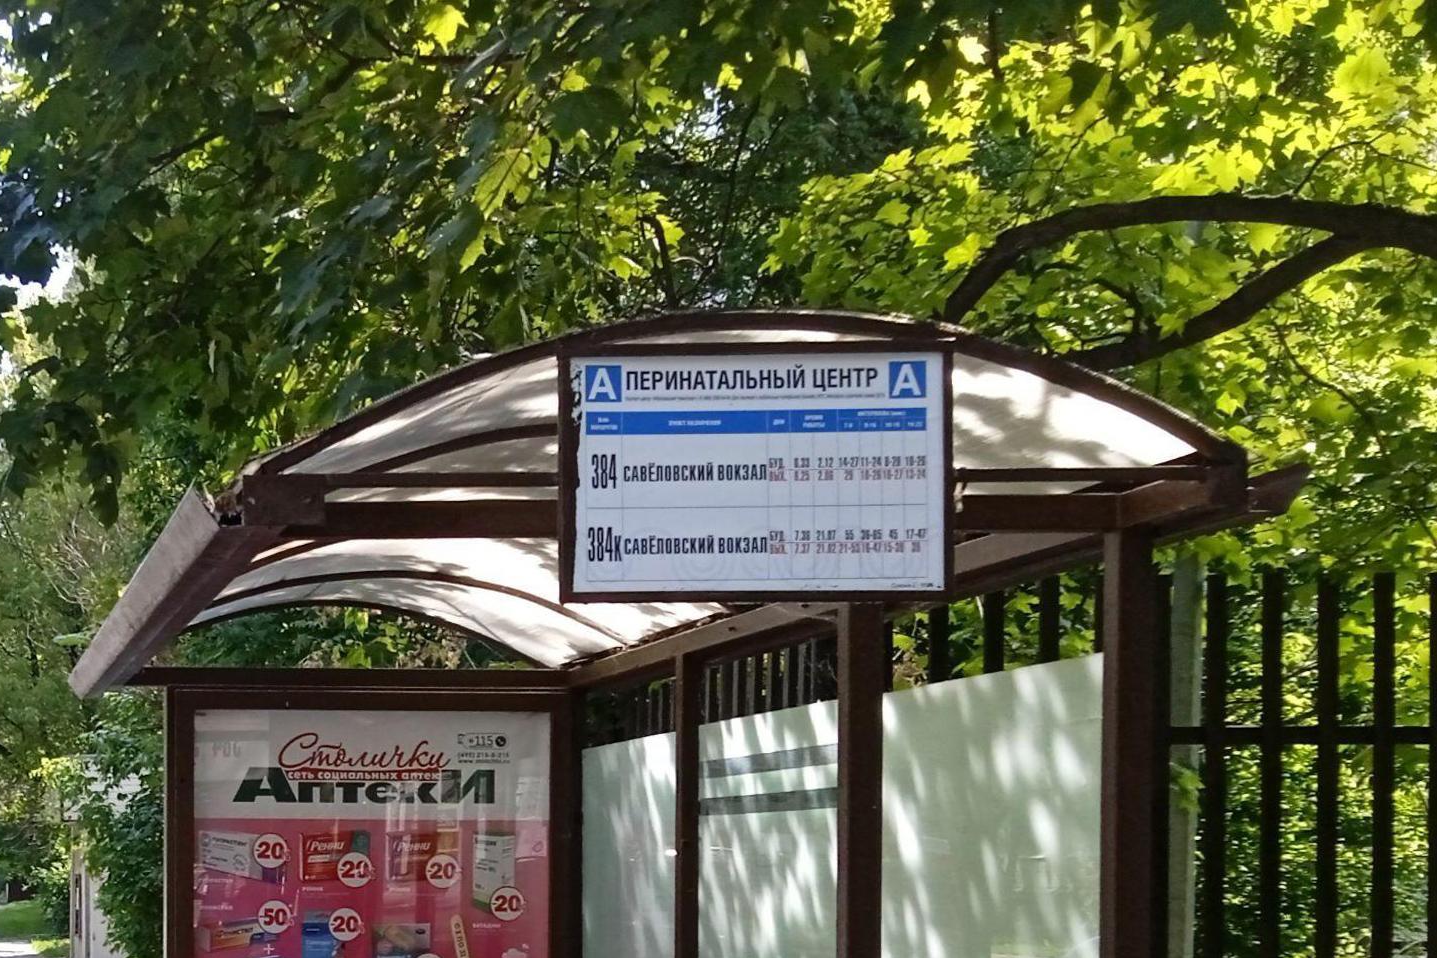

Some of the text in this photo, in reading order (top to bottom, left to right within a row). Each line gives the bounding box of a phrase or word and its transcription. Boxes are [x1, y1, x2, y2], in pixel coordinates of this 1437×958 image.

[626, 365, 805, 391] ПЕРИНАТАЛЬНЫЙ
[813, 367, 879, 392] ЦЕНТР
[591, 454, 617, 489] 384
[624, 462, 767, 483] САВЁЛОВСКИЙ ВОКЗАЛ
[624, 534, 768, 555] САВЁЛОВСКИЙ ВОКЗАЛ
[278, 732, 450, 770] Столички
[287, 769, 440, 782] сеть социальных аптек
